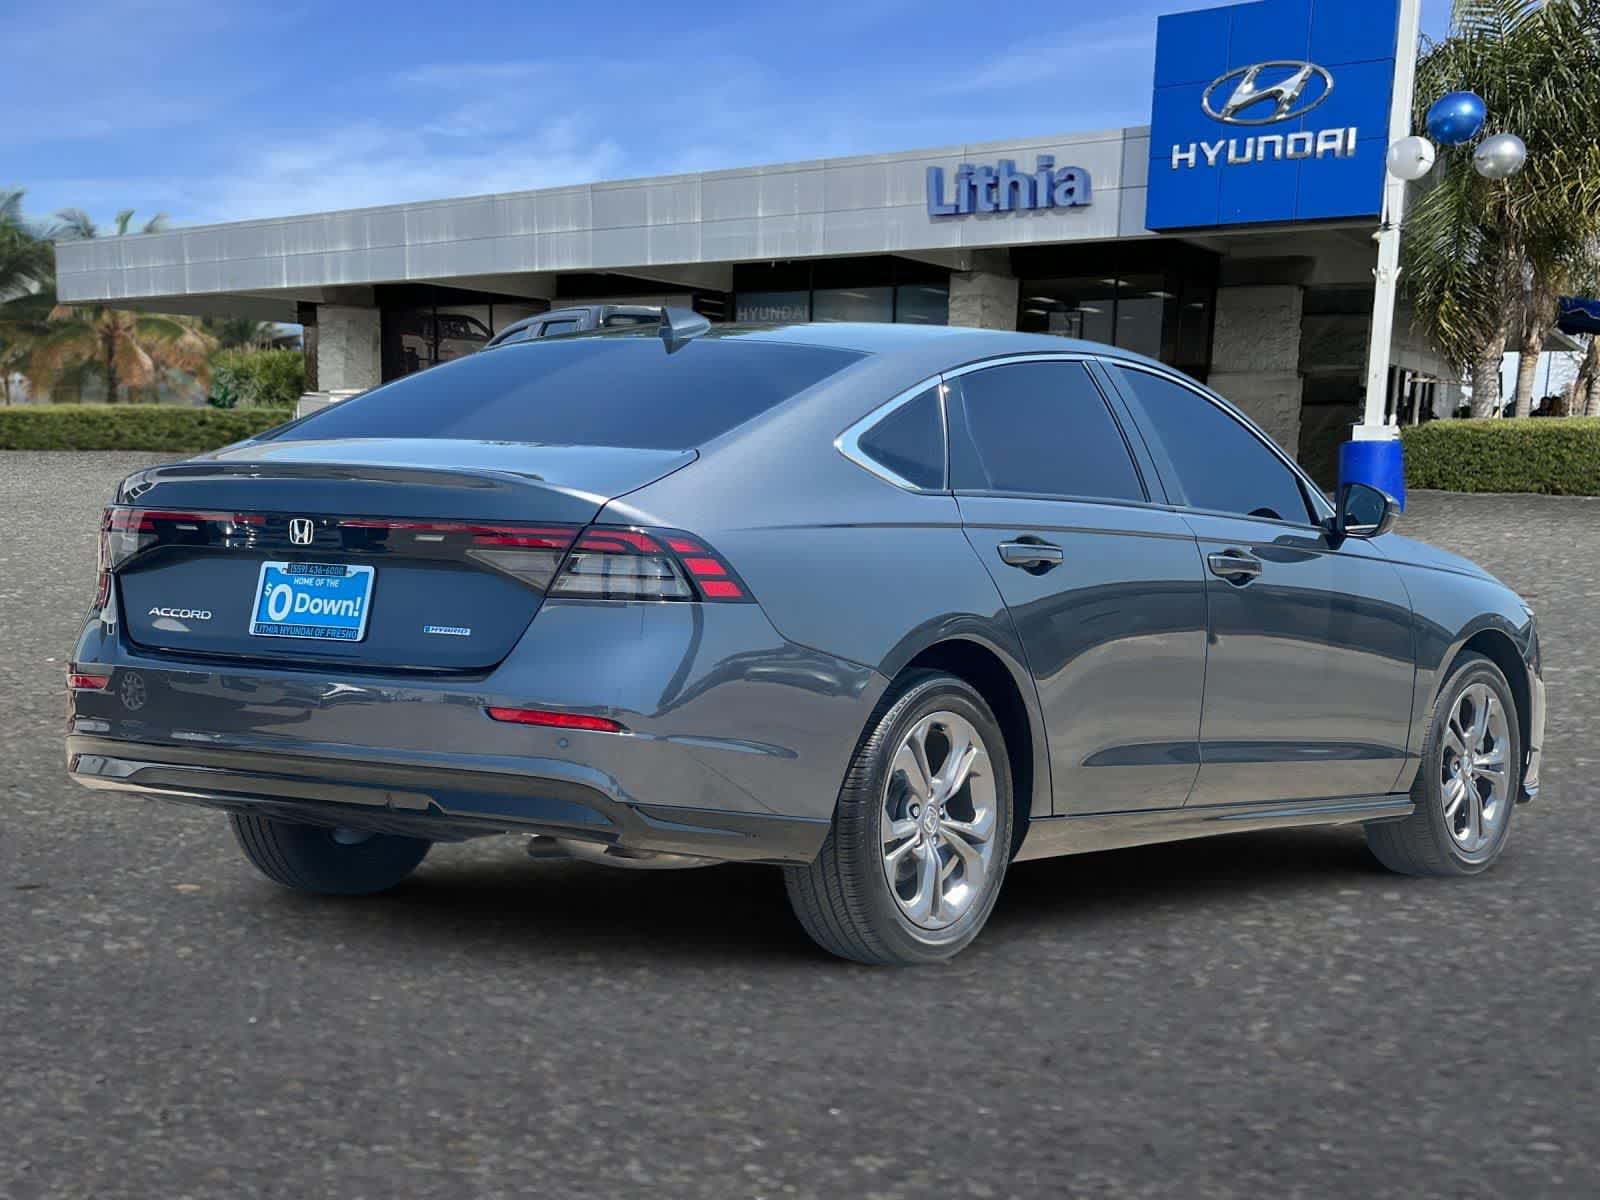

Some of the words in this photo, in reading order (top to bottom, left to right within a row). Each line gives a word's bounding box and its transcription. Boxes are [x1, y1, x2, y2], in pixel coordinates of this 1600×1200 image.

[1171, 127, 1357, 169] HYUNDAI
[926, 155, 1092, 221] Lithia
[736, 305, 809, 321] HYUNDAI
[293, 577, 314, 586] HOME
[315, 579, 325, 587] OF
[326, 580, 340, 588] THE
[294, 592, 362, 617] Down!
[148, 607, 212, 620] ACCORD
[255, 623, 278, 634] LITHIA
[279, 625, 313, 637] HYUNDAI
[314, 628, 325, 637] OF
[326, 629, 357, 640] FRESNO
